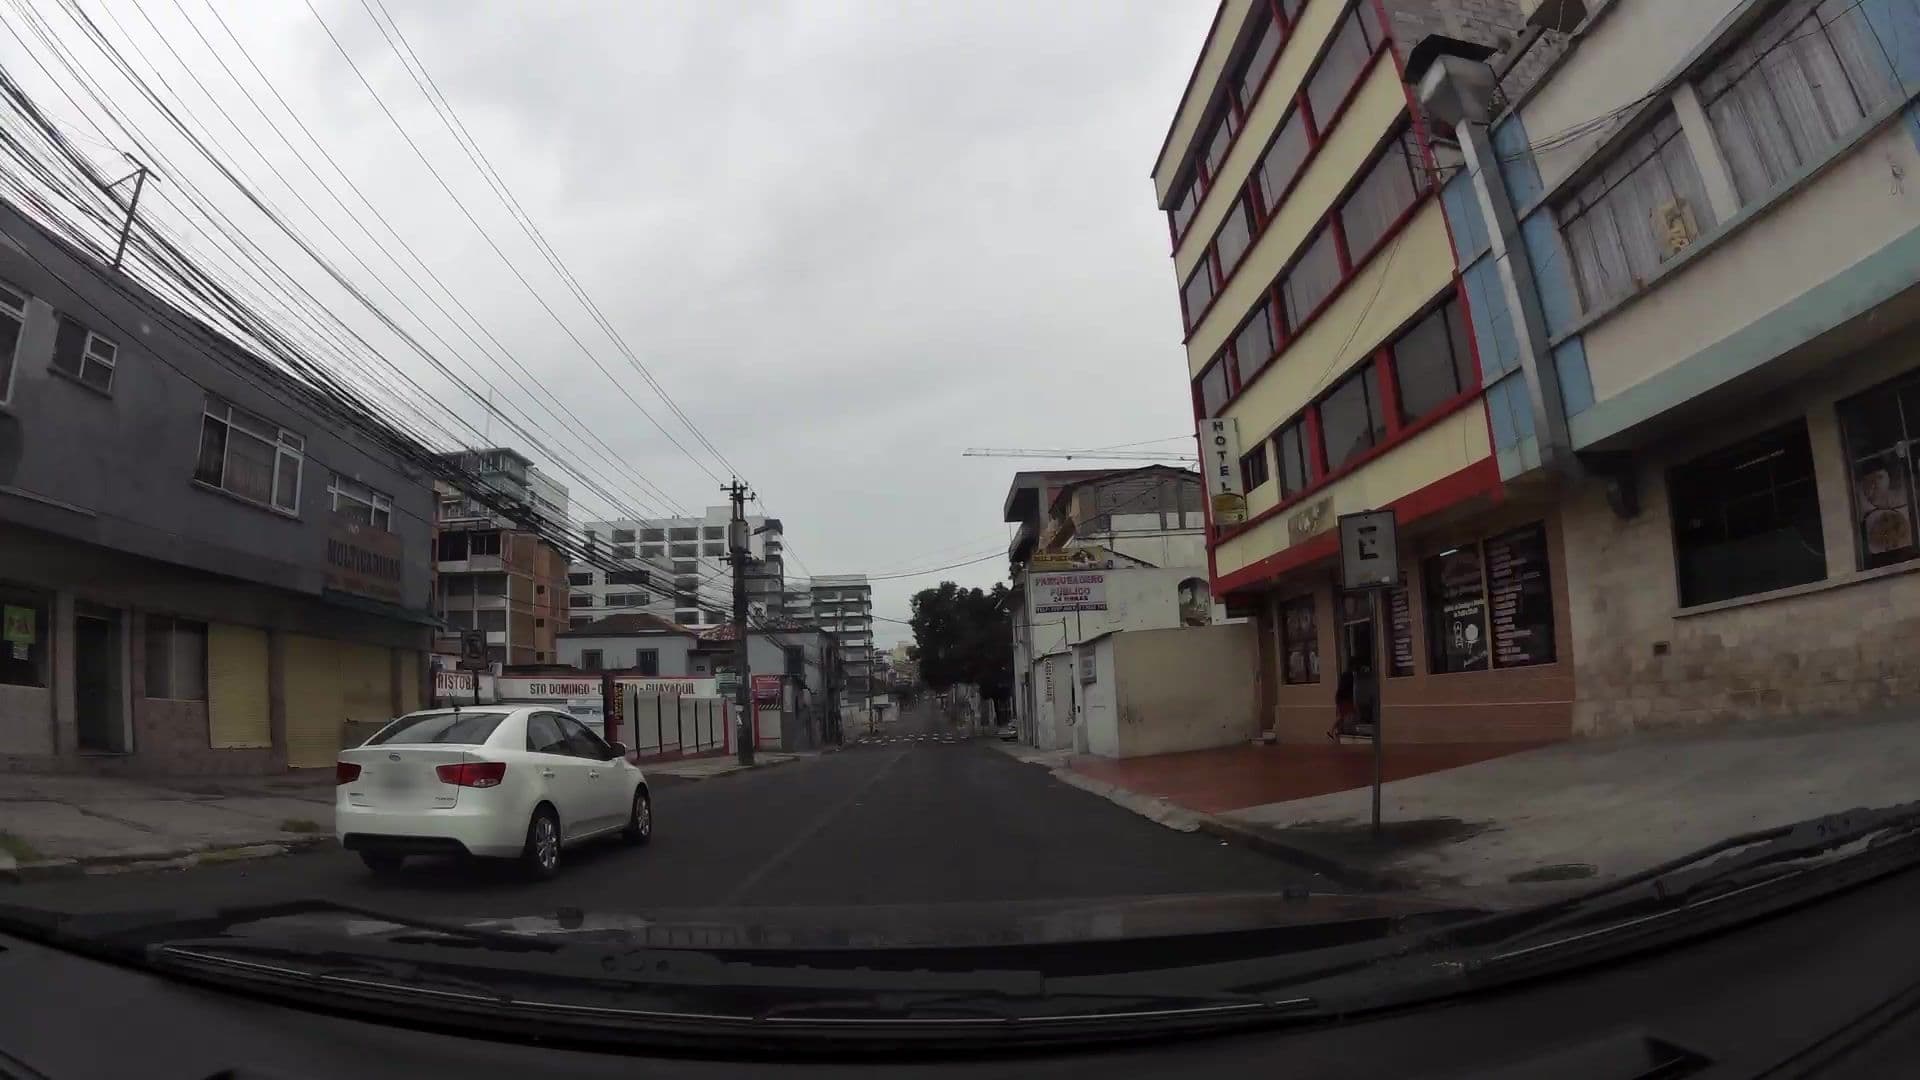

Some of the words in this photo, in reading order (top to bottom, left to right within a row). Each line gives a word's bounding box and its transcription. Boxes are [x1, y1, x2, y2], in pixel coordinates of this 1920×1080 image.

[1213, 421, 1231, 493] HOTEL
[1035, 574, 1104, 586] PARQUEADERO
[530, 683, 546, 695] STO
[549, 683, 590, 696] DOMINGO
